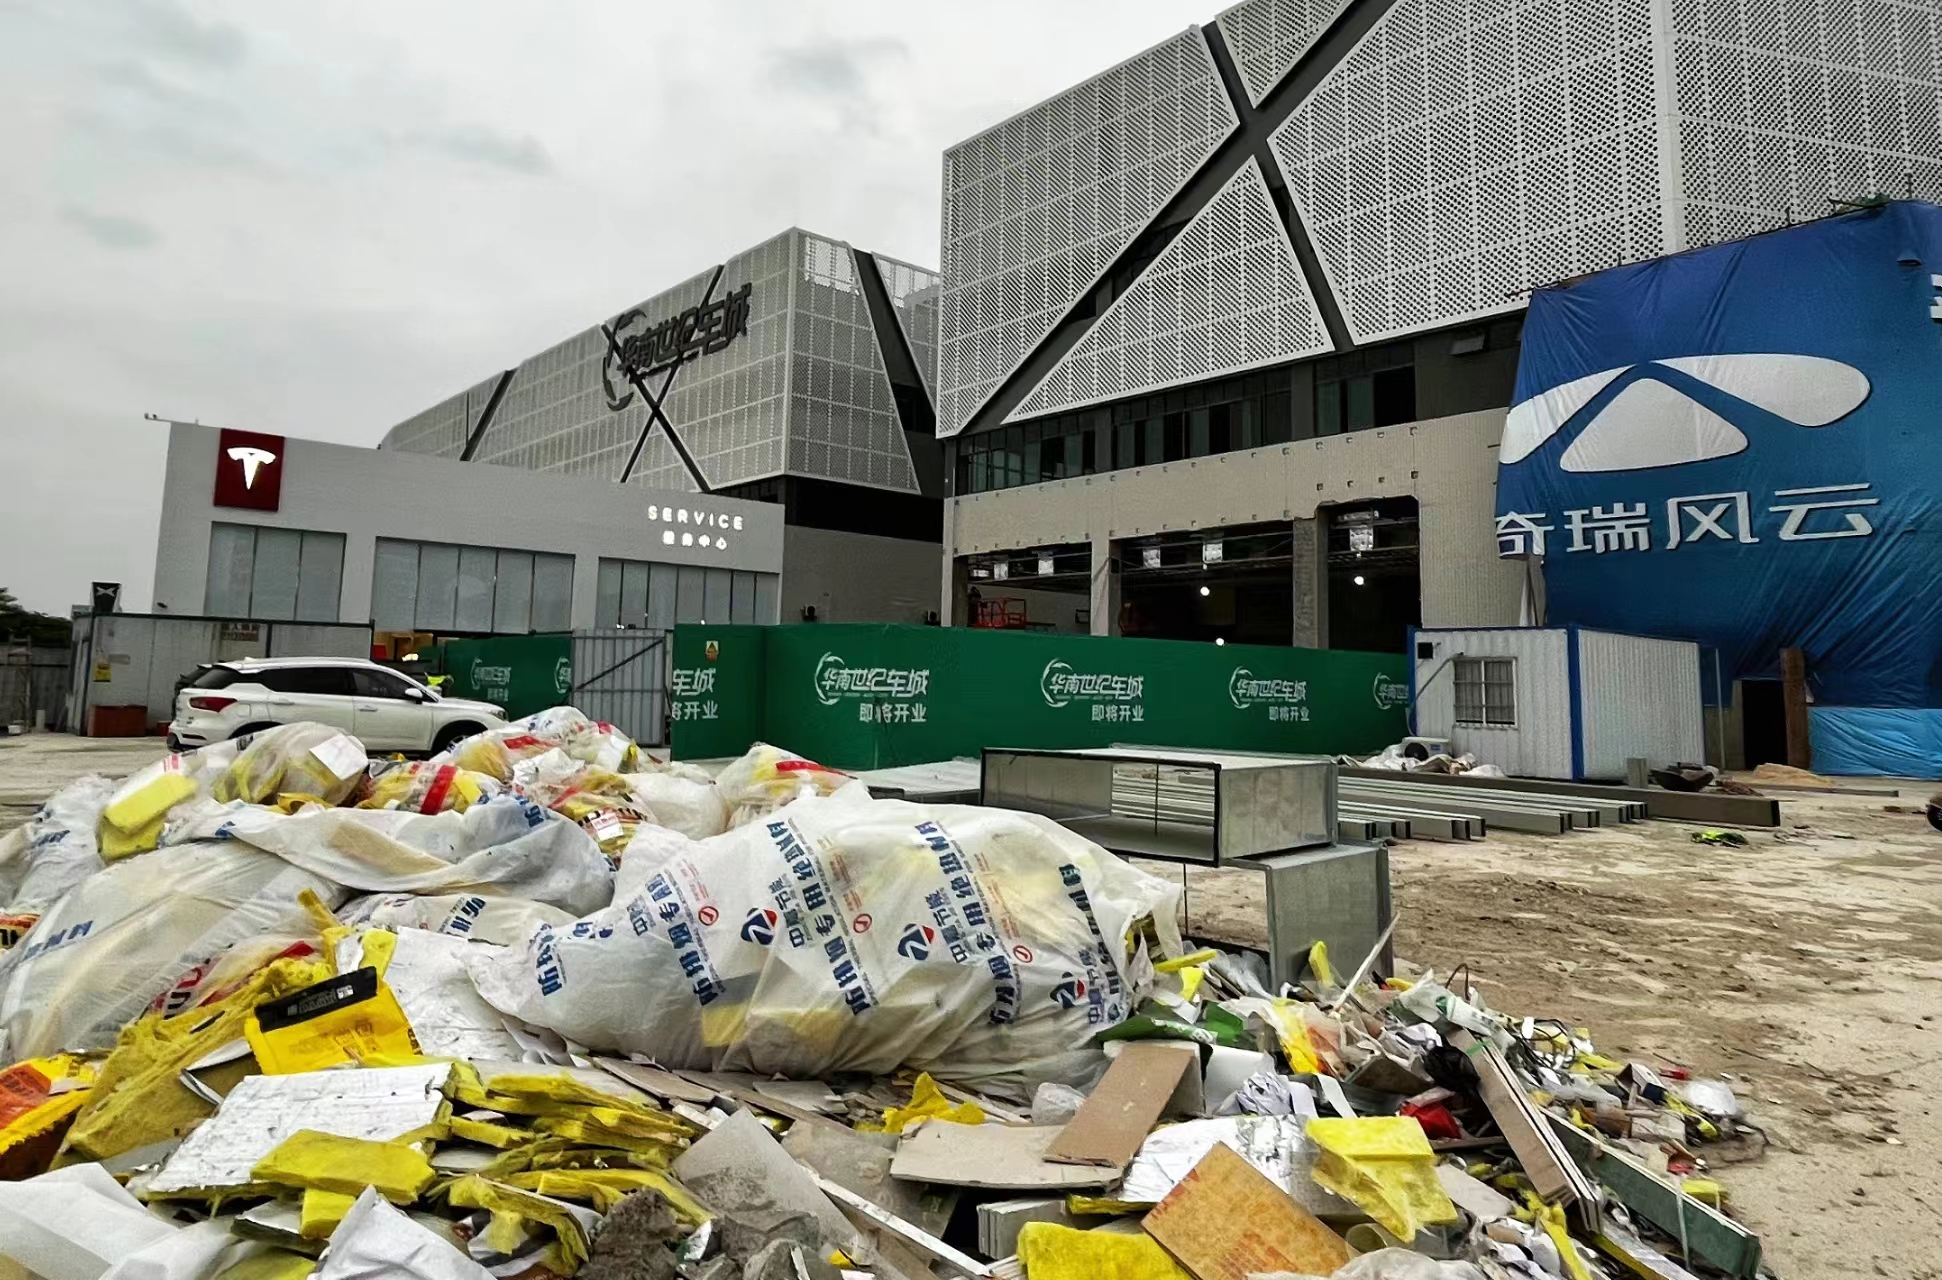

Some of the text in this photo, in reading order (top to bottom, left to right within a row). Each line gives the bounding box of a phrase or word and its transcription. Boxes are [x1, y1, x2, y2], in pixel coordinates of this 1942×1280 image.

[648, 505, 743, 530] SERVICE
[1496, 482, 1880, 557] 奇瑞风云
[662, 530, 727, 550] 中心
[821, 668, 929, 697] 华南世纪车城
[1049, 673, 1144, 699] 华南世纪车城
[1235, 679, 1306, 702] 华南世纪车城
[860, 703, 927, 723] 即将开业
[1091, 704, 1144, 721] 即将开业
[925, 889, 968, 963] 中节能
